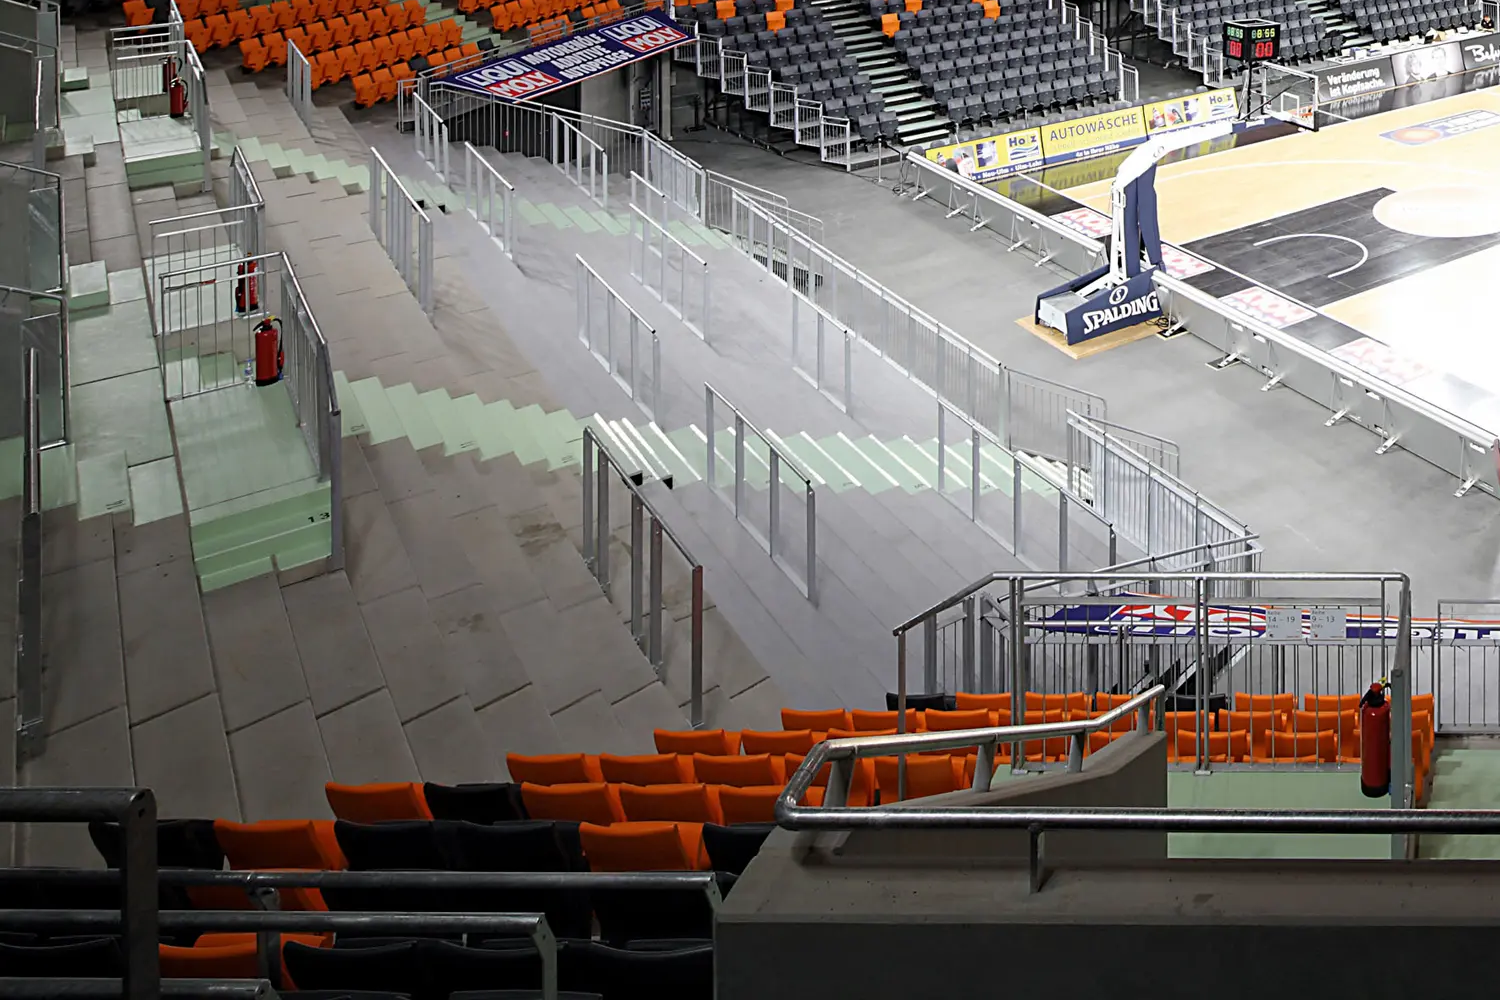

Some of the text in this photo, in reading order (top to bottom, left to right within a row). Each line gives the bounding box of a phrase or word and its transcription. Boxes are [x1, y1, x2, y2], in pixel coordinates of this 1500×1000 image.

[604, 18, 663, 41] LIQUI
[626, 27, 679, 51] MOLY
[521, 32, 607, 66] MOTORENÖLE
[551, 44, 612, 70] ADDITIVE
[461, 58, 532, 87] LIQUI
[559, 49, 635, 80] AUTOPFLEGE
[491, 71, 554, 97] MOLY
[1327, 67, 1380, 90] Veränderung
[1049, 113, 1139, 142] AUTOWÄSCHE
[1082, 291, 1161, 336] SPALDING
